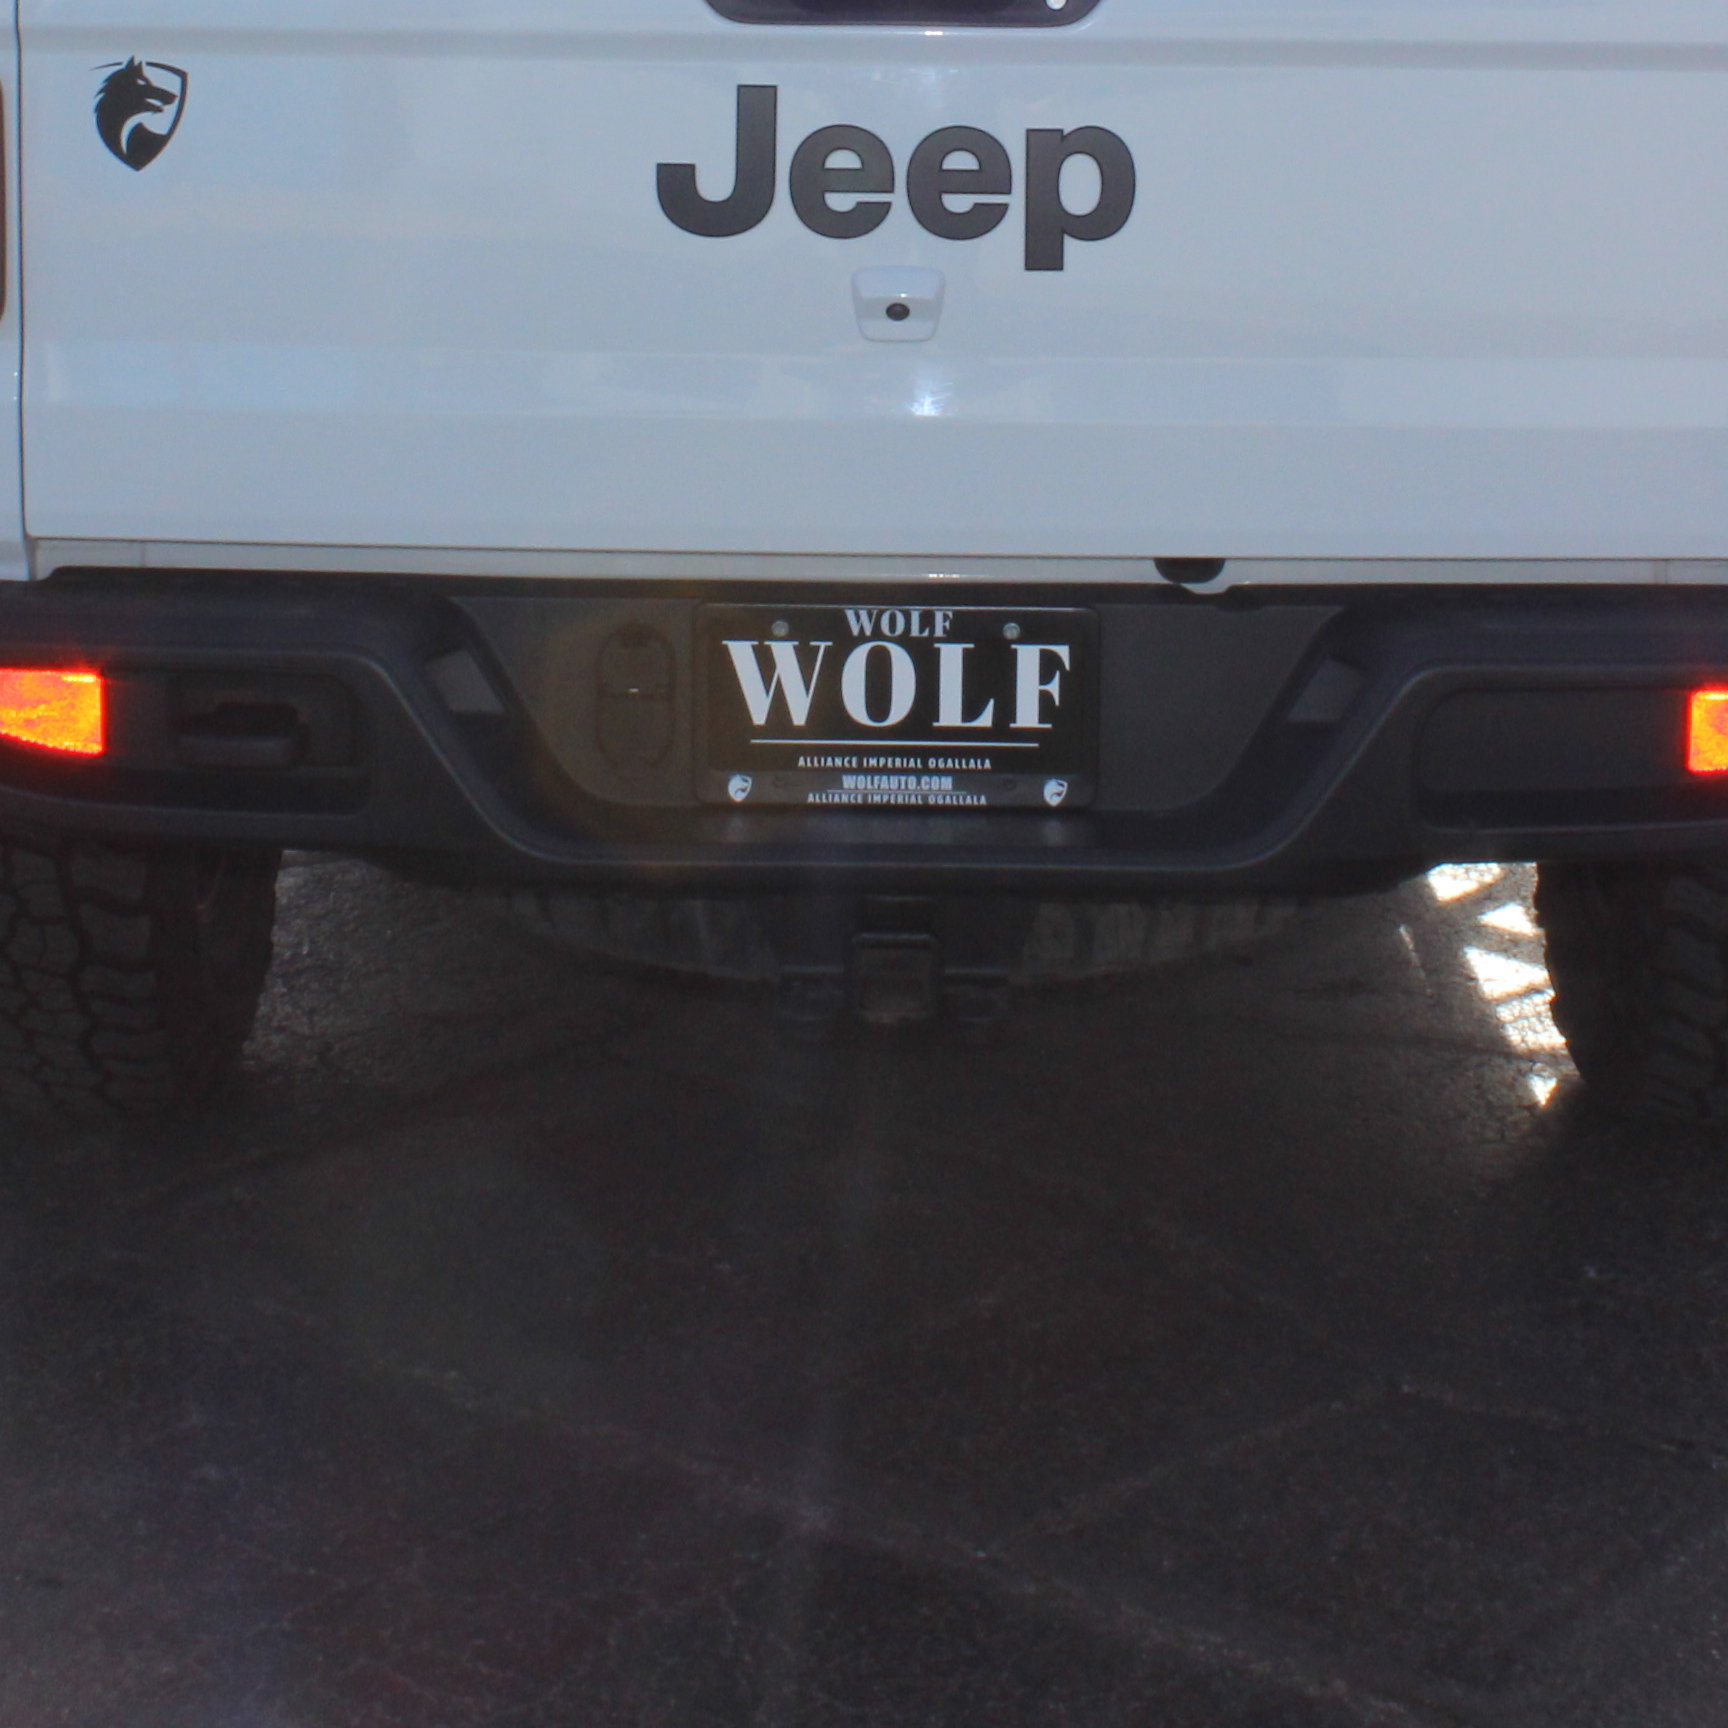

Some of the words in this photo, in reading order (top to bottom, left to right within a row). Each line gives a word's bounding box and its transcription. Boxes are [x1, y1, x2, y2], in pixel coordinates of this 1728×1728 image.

[656, 84, 1136, 271] Jeep
[844, 608, 953, 638] WOLF
[722, 640, 1070, 728] WOLF
[798, 756, 858, 768] ALLIANCE
[863, 757, 922, 769] IMPERIAL
[928, 758, 991, 770] OGALLALA
[842, 775, 952, 790] WOLFAUTO.COM
[807, 793, 864, 804] ALLIANCE
[867, 794, 922, 805] IMPERIAL
[928, 795, 987, 805] OGALLALA
